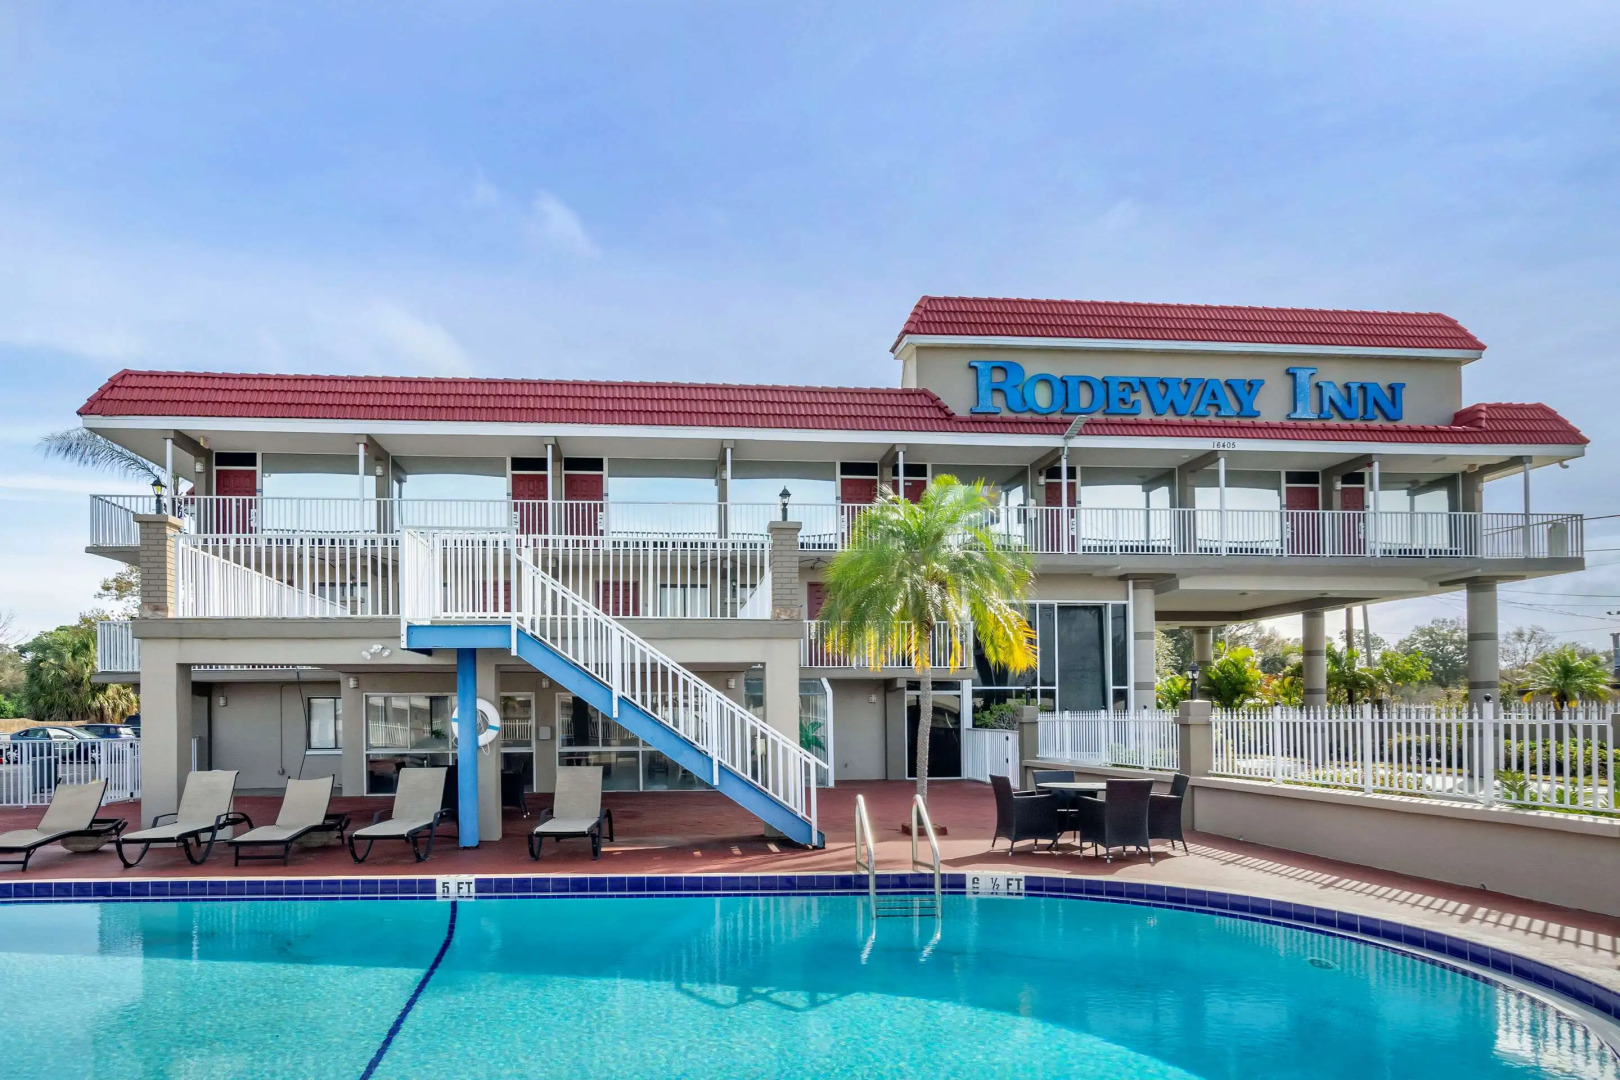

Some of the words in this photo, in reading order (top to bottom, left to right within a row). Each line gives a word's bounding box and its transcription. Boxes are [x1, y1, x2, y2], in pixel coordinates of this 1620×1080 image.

[968, 360, 1265, 416] RODEWAY
[1286, 366, 1406, 421] INN
[1212, 441, 1236, 449] 16405
[441, 881, 450, 896] 5
